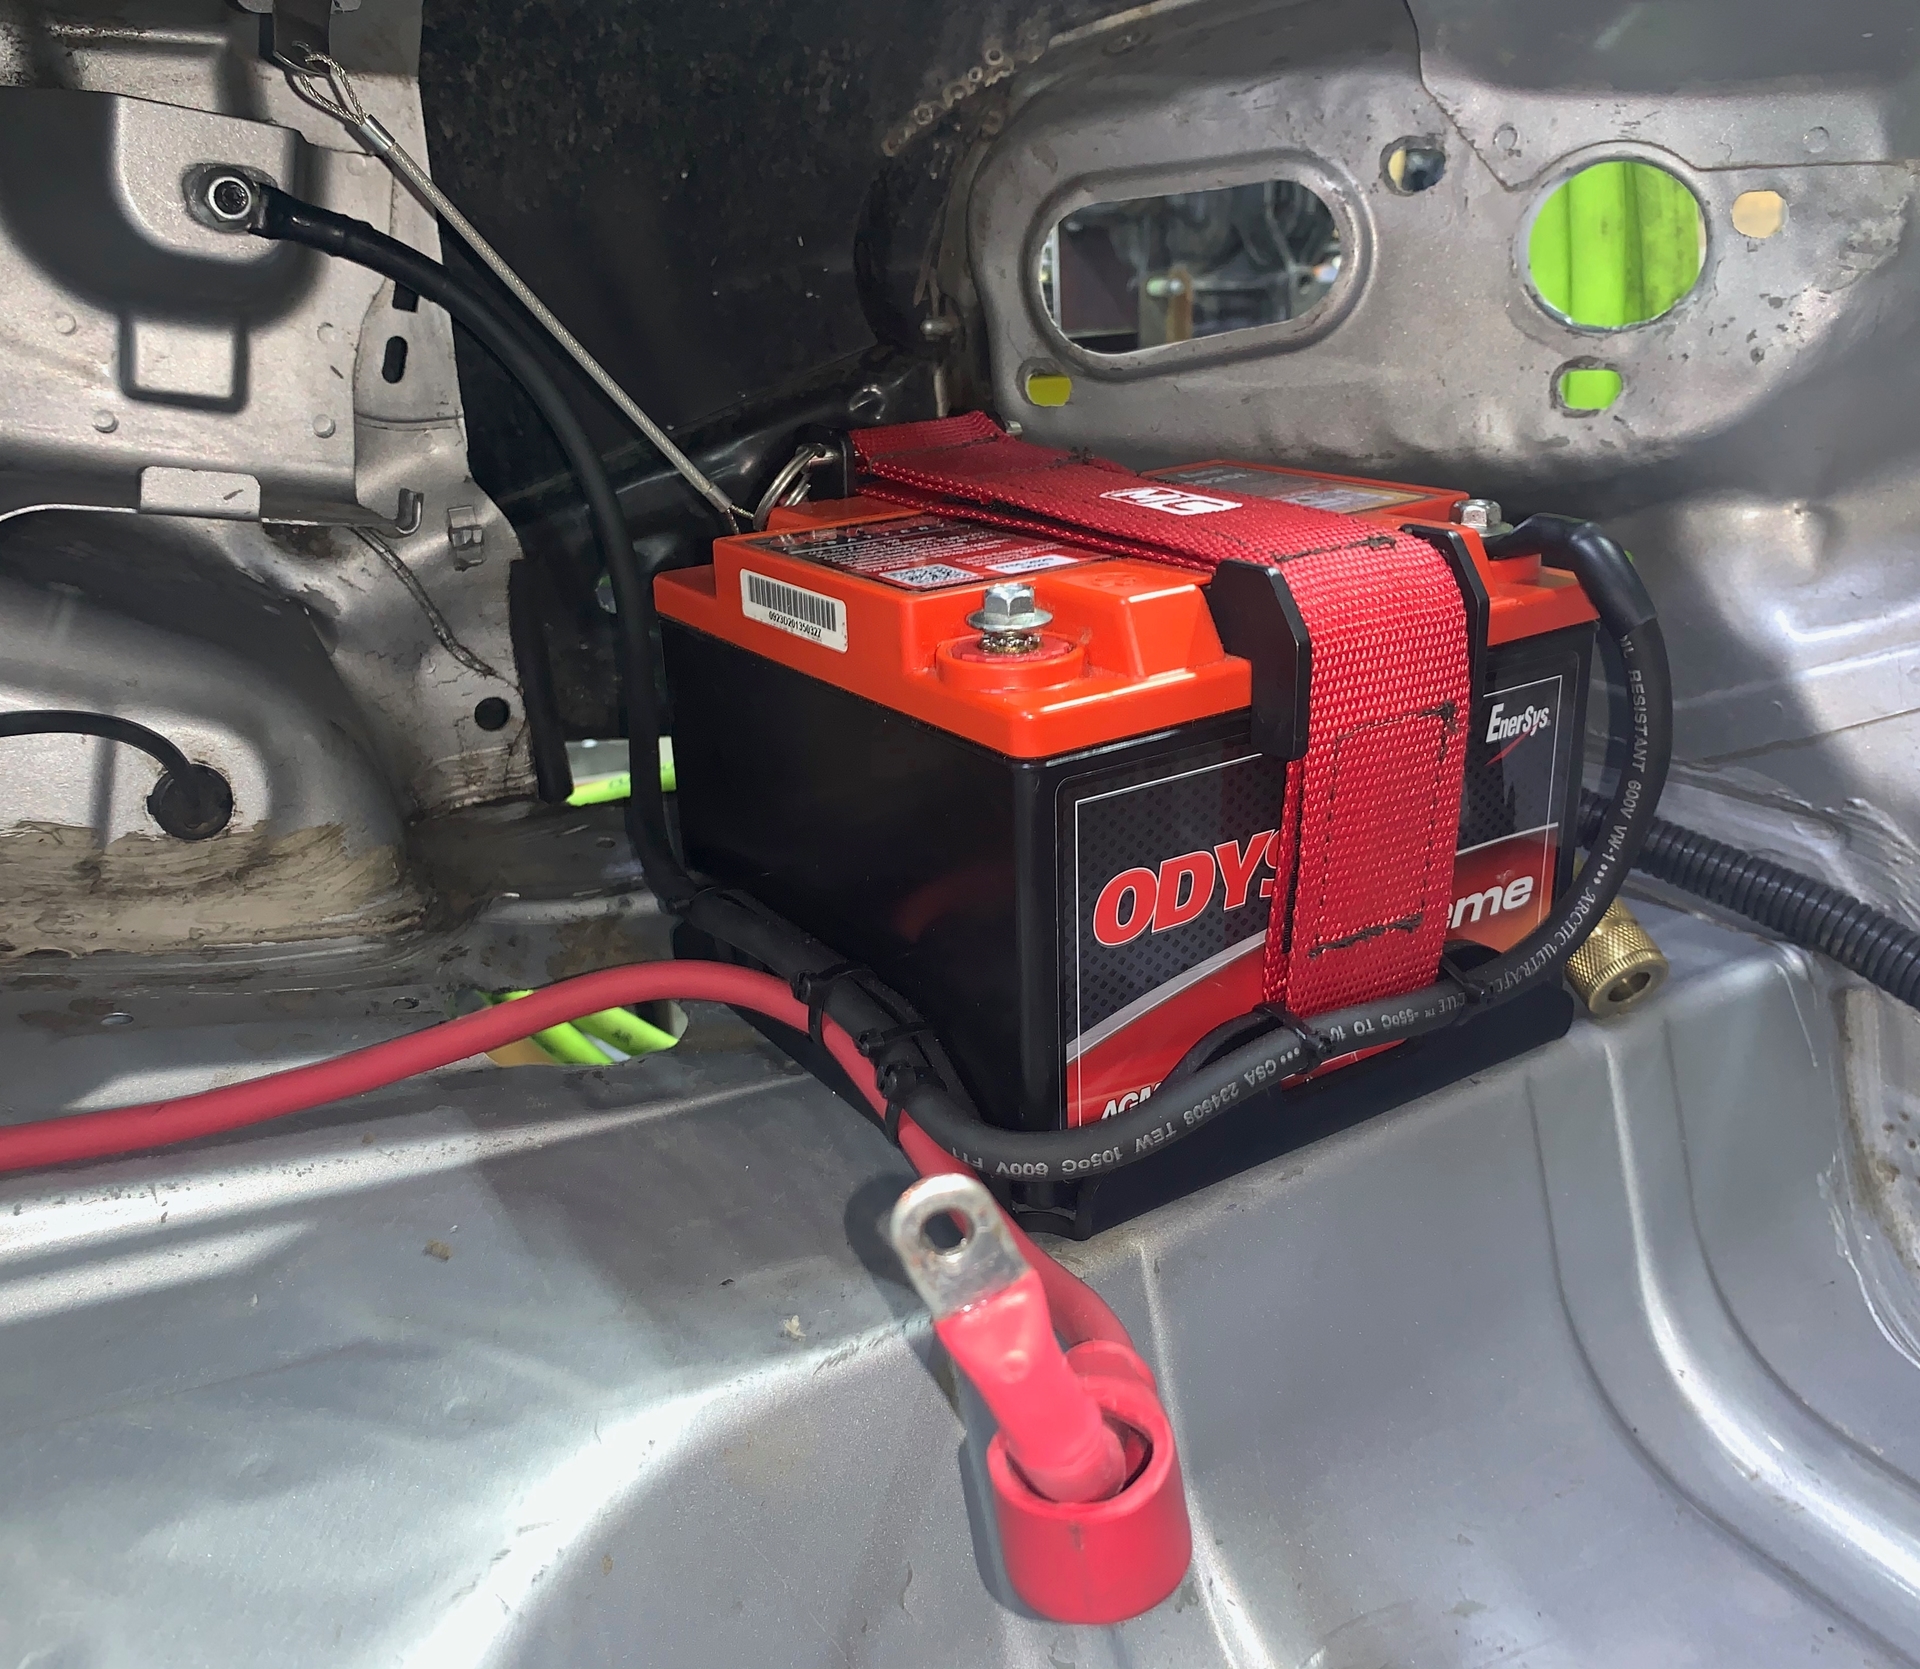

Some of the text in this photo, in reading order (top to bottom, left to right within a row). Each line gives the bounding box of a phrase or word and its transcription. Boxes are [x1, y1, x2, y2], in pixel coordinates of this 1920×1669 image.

[1486, 702, 1550, 743] EnerSys
[1627, 669, 1648, 772] RESISTANT
[1619, 780, 1642, 819] 600V
[1602, 824, 1628, 861] VW-1
[1553, 886, 1597, 946] ARCTIC
[1488, 943, 1558, 993] ULTRAFL
[1438, 992, 1467, 1013] LUE
[1353, 1018, 1376, 1036] TO
[1243, 1059, 1277, 1087] CSA
[1183, 1081, 1240, 1126] 234608
[1134, 1121, 1177, 1154] TEW
[995, 1161, 1049, 1177] 600V
